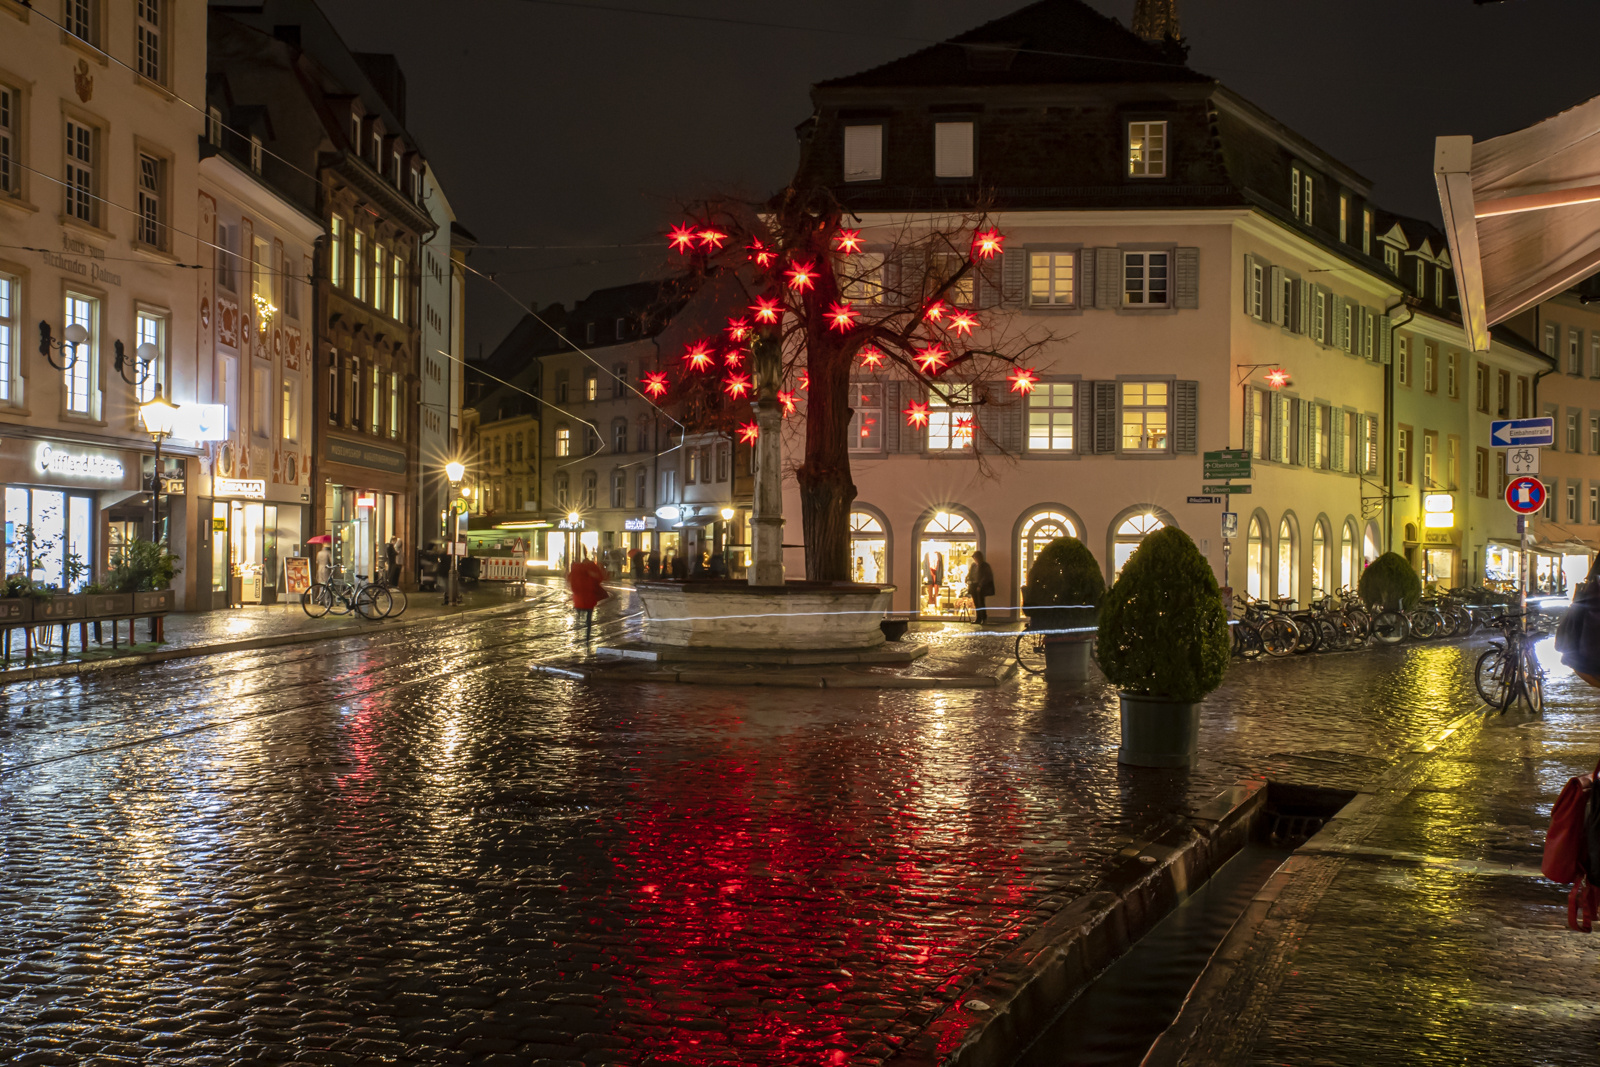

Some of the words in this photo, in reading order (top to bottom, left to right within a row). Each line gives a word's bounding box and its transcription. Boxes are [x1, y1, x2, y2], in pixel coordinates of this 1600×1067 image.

[63, 231, 85, 254] Haus
[88, 244, 105, 261] zum
[91, 262, 121, 286] Palmen
[1509, 428, 1550, 437] Einbahnstraße
